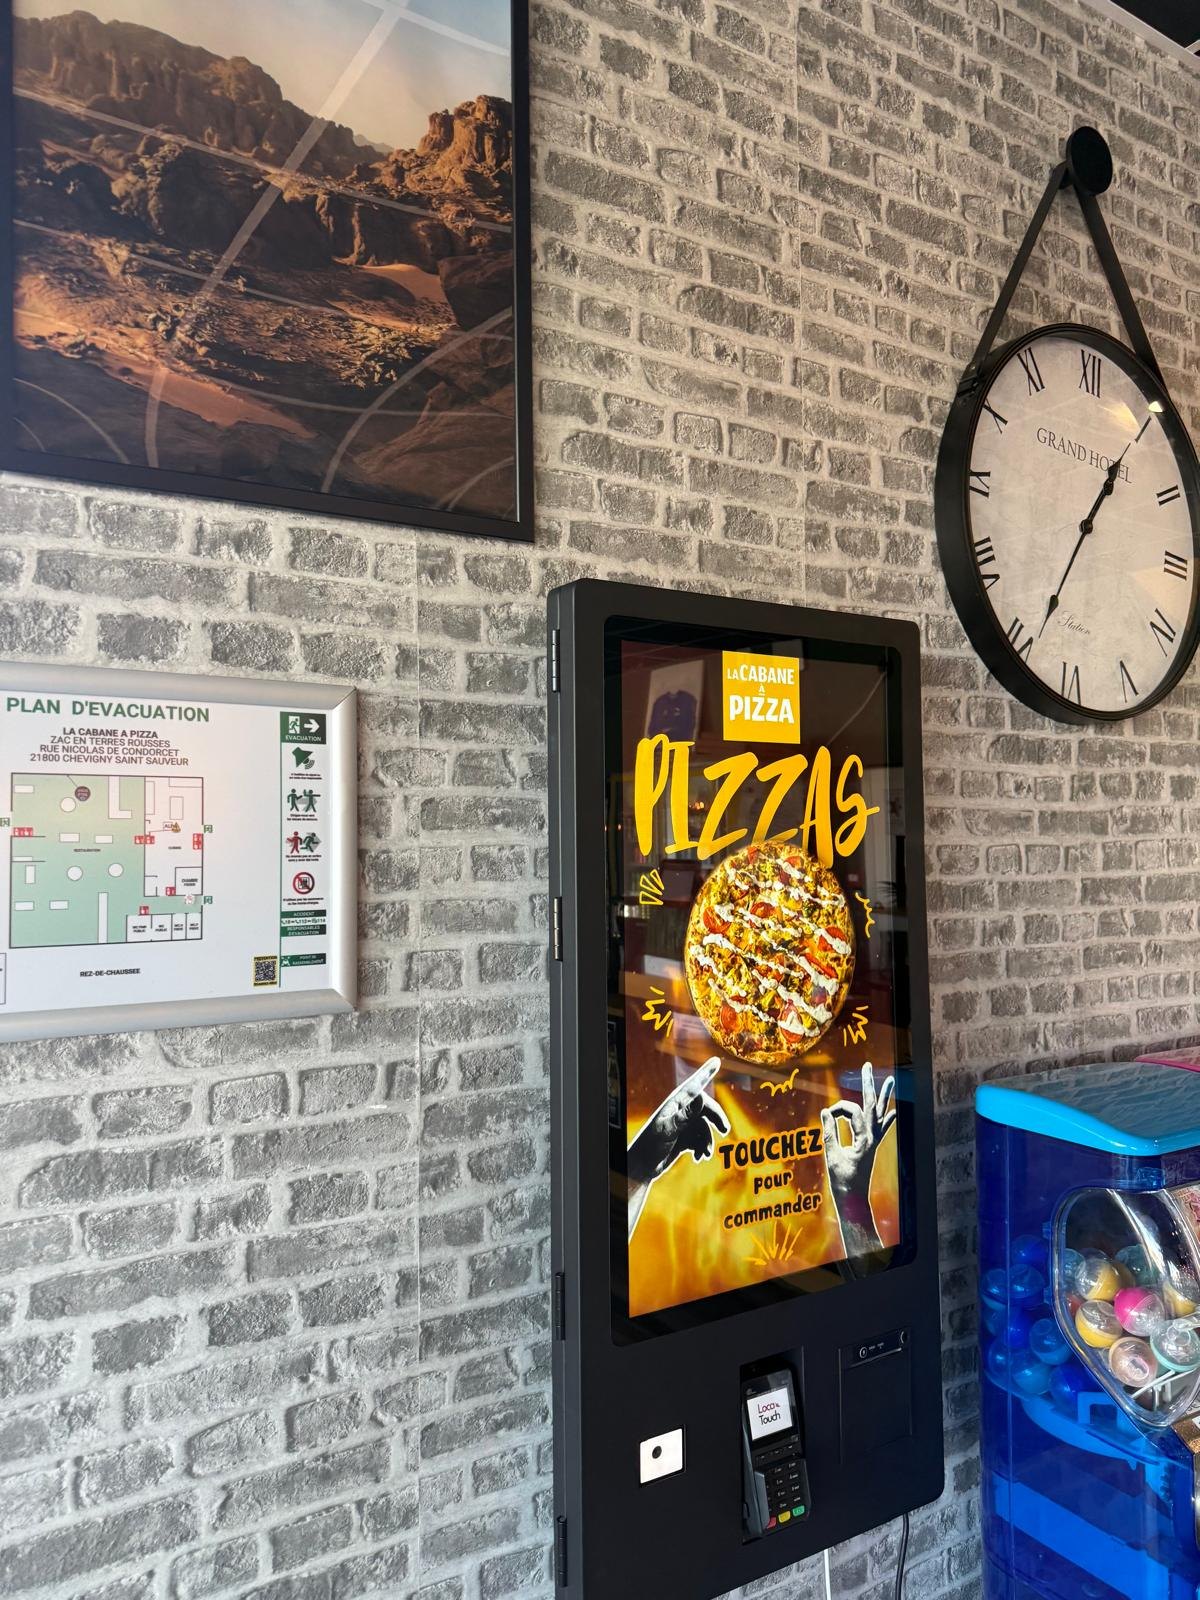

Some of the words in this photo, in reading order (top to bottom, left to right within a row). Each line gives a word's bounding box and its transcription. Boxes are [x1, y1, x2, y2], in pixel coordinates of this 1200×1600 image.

[1079, 349, 1102, 399] XII
[1036, 427, 1087, 462] GRAND
[727, 667, 739, 680] LA
[739, 663, 795, 685] CABANE
[6, 697, 61, 714] PLAN
[72, 700, 210, 722] D'EVACUATION
[729, 695, 795, 724] PIZZA
[50, 736, 71, 745] ZAC
[73, 736, 87, 745] EN
[90, 737, 126, 747] TERRES
[128, 738, 171, 748] ROUSSES
[63, 727, 77, 736] LA
[78, 728, 119, 738] CABANE
[120, 729, 128, 738] A
[130, 730, 158, 739] PIZZA
[30, 753, 60, 762] 21800
[63, 754, 113, 764] CHEVIGNY
[115, 755, 144, 765] SAINT
[145, 756, 189, 766] SAUVEUR
[39, 744, 60, 753] RUE
[62, 745, 105, 755] NICOLAS
[107, 746, 119, 755] DE
[121, 747, 180, 757] CONDORCET
[634, 733, 880, 869] PIZZAS
[79, 968, 141, 978] REZ-DE-CHAUSSEE
[718, 1128, 823, 1170] TOUCHEZ
[723, 1193, 821, 1230] commander
[758, 1409, 781, 1425] Touch
